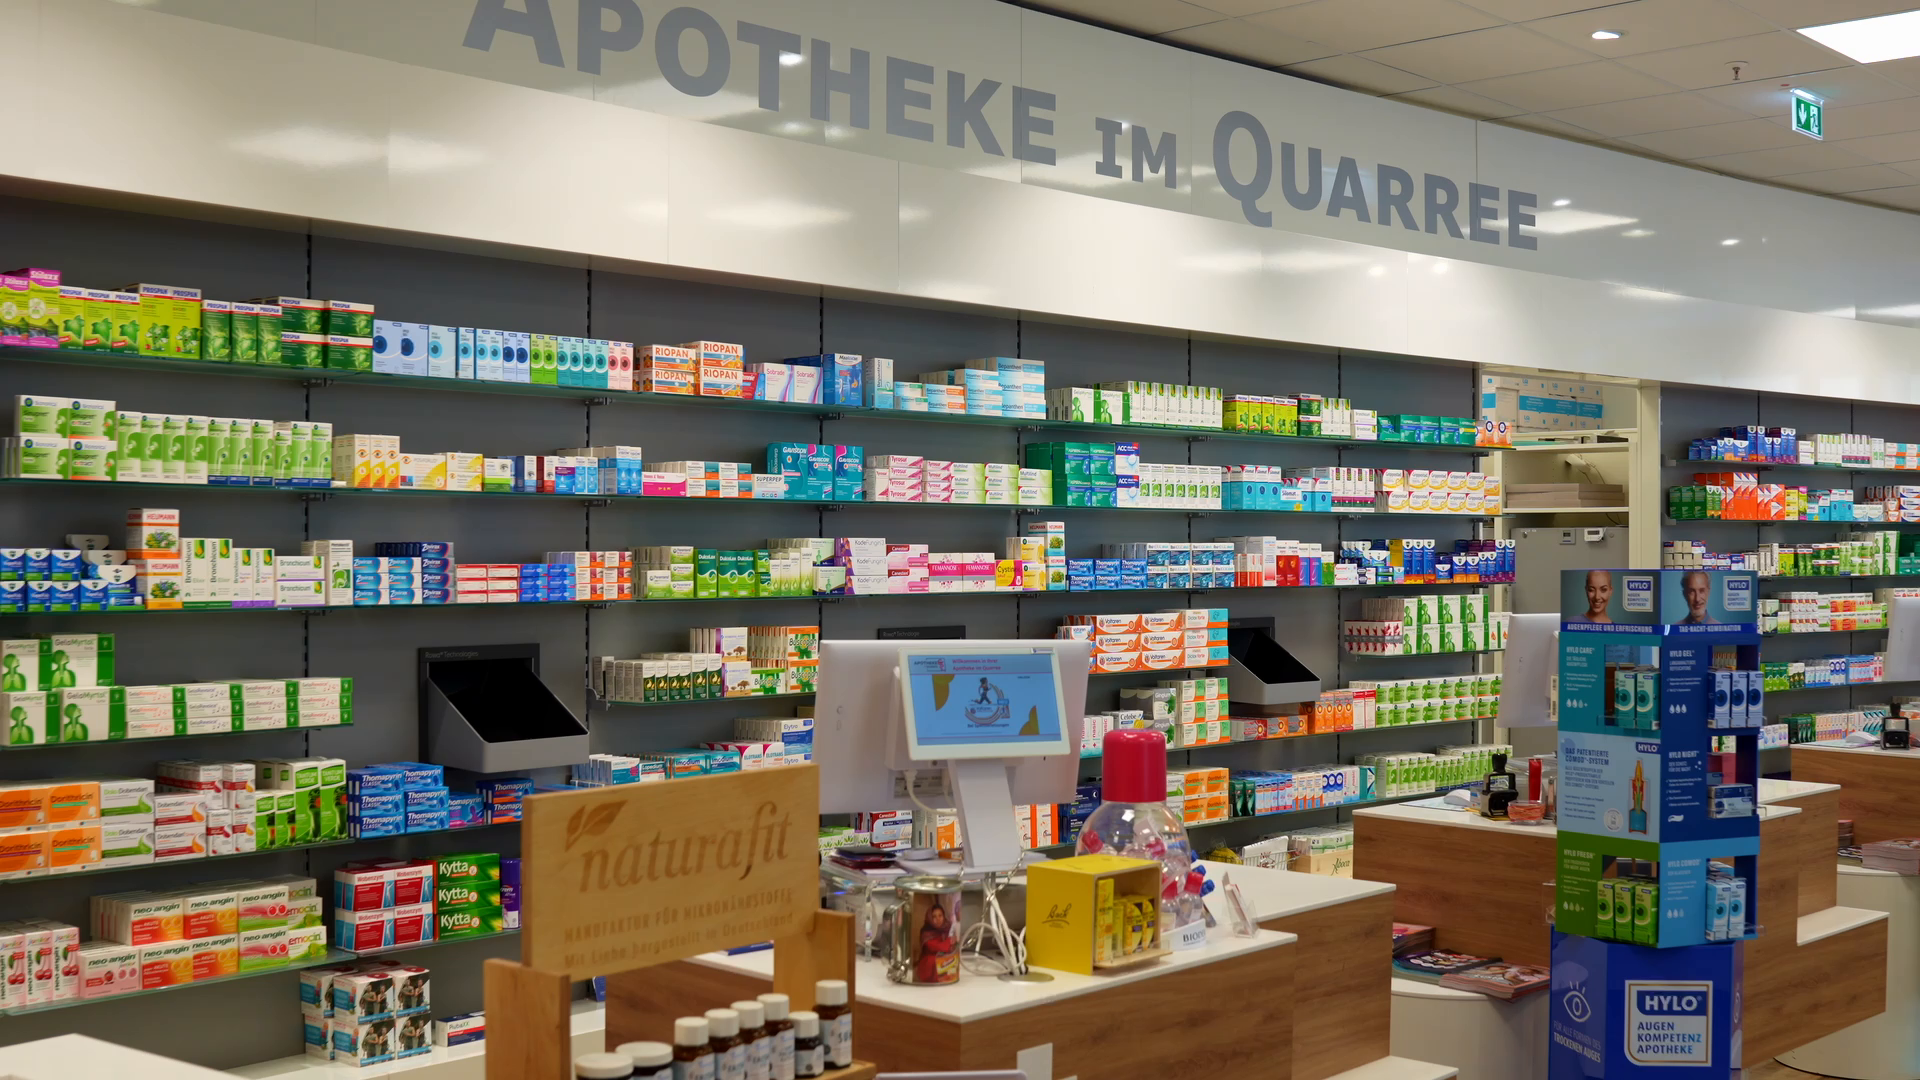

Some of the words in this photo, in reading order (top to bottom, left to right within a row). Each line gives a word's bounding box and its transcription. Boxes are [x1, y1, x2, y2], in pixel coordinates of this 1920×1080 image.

[462, 0, 1056, 166] APOTHEKE
[1095, 117, 1177, 189] IM
[1213, 110, 1538, 250] QUARREE
[655, 348, 689, 358] RIOPAN
[704, 343, 738, 354] RIOPAN
[655, 370, 687, 381] RIOPAN
[704, 369, 738, 380] RIOPAN
[767, 368, 785, 376] Sobrade
[184, 541, 192, 583] Bronchicum
[210, 541, 218, 583] Bronchicum
[1567, 624, 1602, 632] AUGENPFLEGE
[1616, 625, 1653, 633] ERFRISCHUNG
[1679, 625, 1741, 633] TAG-NACHT-KOMBINATION
[789, 638, 817, 647] Buscopan
[791, 671, 818, 680] Buscopan
[754, 678, 782, 686] Buscopan
[1576, 748, 1609, 758] PATENTIERTE
[1638, 744, 1658, 752] HYLO
[362, 773, 402, 782] Thomapyrin
[495, 783, 532, 791] Thomapyrin
[51, 793, 93, 803] Dorithricin
[362, 794, 402, 802] Thomapyrin
[408, 790, 447, 799] Thomapyrin
[362, 816, 402, 824] Thomapyrin
[408, 811, 447, 820] Thomapyrin
[52, 836, 95, 848] Dorithricin
[579, 800, 793, 894] naturafit
[439, 861, 468, 878] Kytta
[242, 894, 260, 903] neo
[261, 891, 286, 900] angin
[439, 887, 468, 903] Kytta
[191, 900, 208, 909] neo
[209, 896, 235, 907] angin
[564, 914, 650, 944] MANUFAKTUR
[656, 906, 678, 925] FÜR
[683, 887, 793, 922] MIKRONÄHRSTOFFE
[441, 913, 471, 930] Kytta
[244, 934, 260, 942] neo
[262, 930, 287, 940] angin
[1553, 1020, 1561, 1030] FÜR
[1562, 1024, 1573, 1034] ALLE
[1573, 1028, 1592, 1042] FORMEN
[1637, 1022, 1675, 1031] AUGEN
[1637, 1034, 1702, 1043] KOMPETENZ
[1553, 1031, 1583, 1054] TROCKENEN
[1583, 1047, 1601, 1063] AUGES
[1637, 1045, 1693, 1054] APOTHEKE
